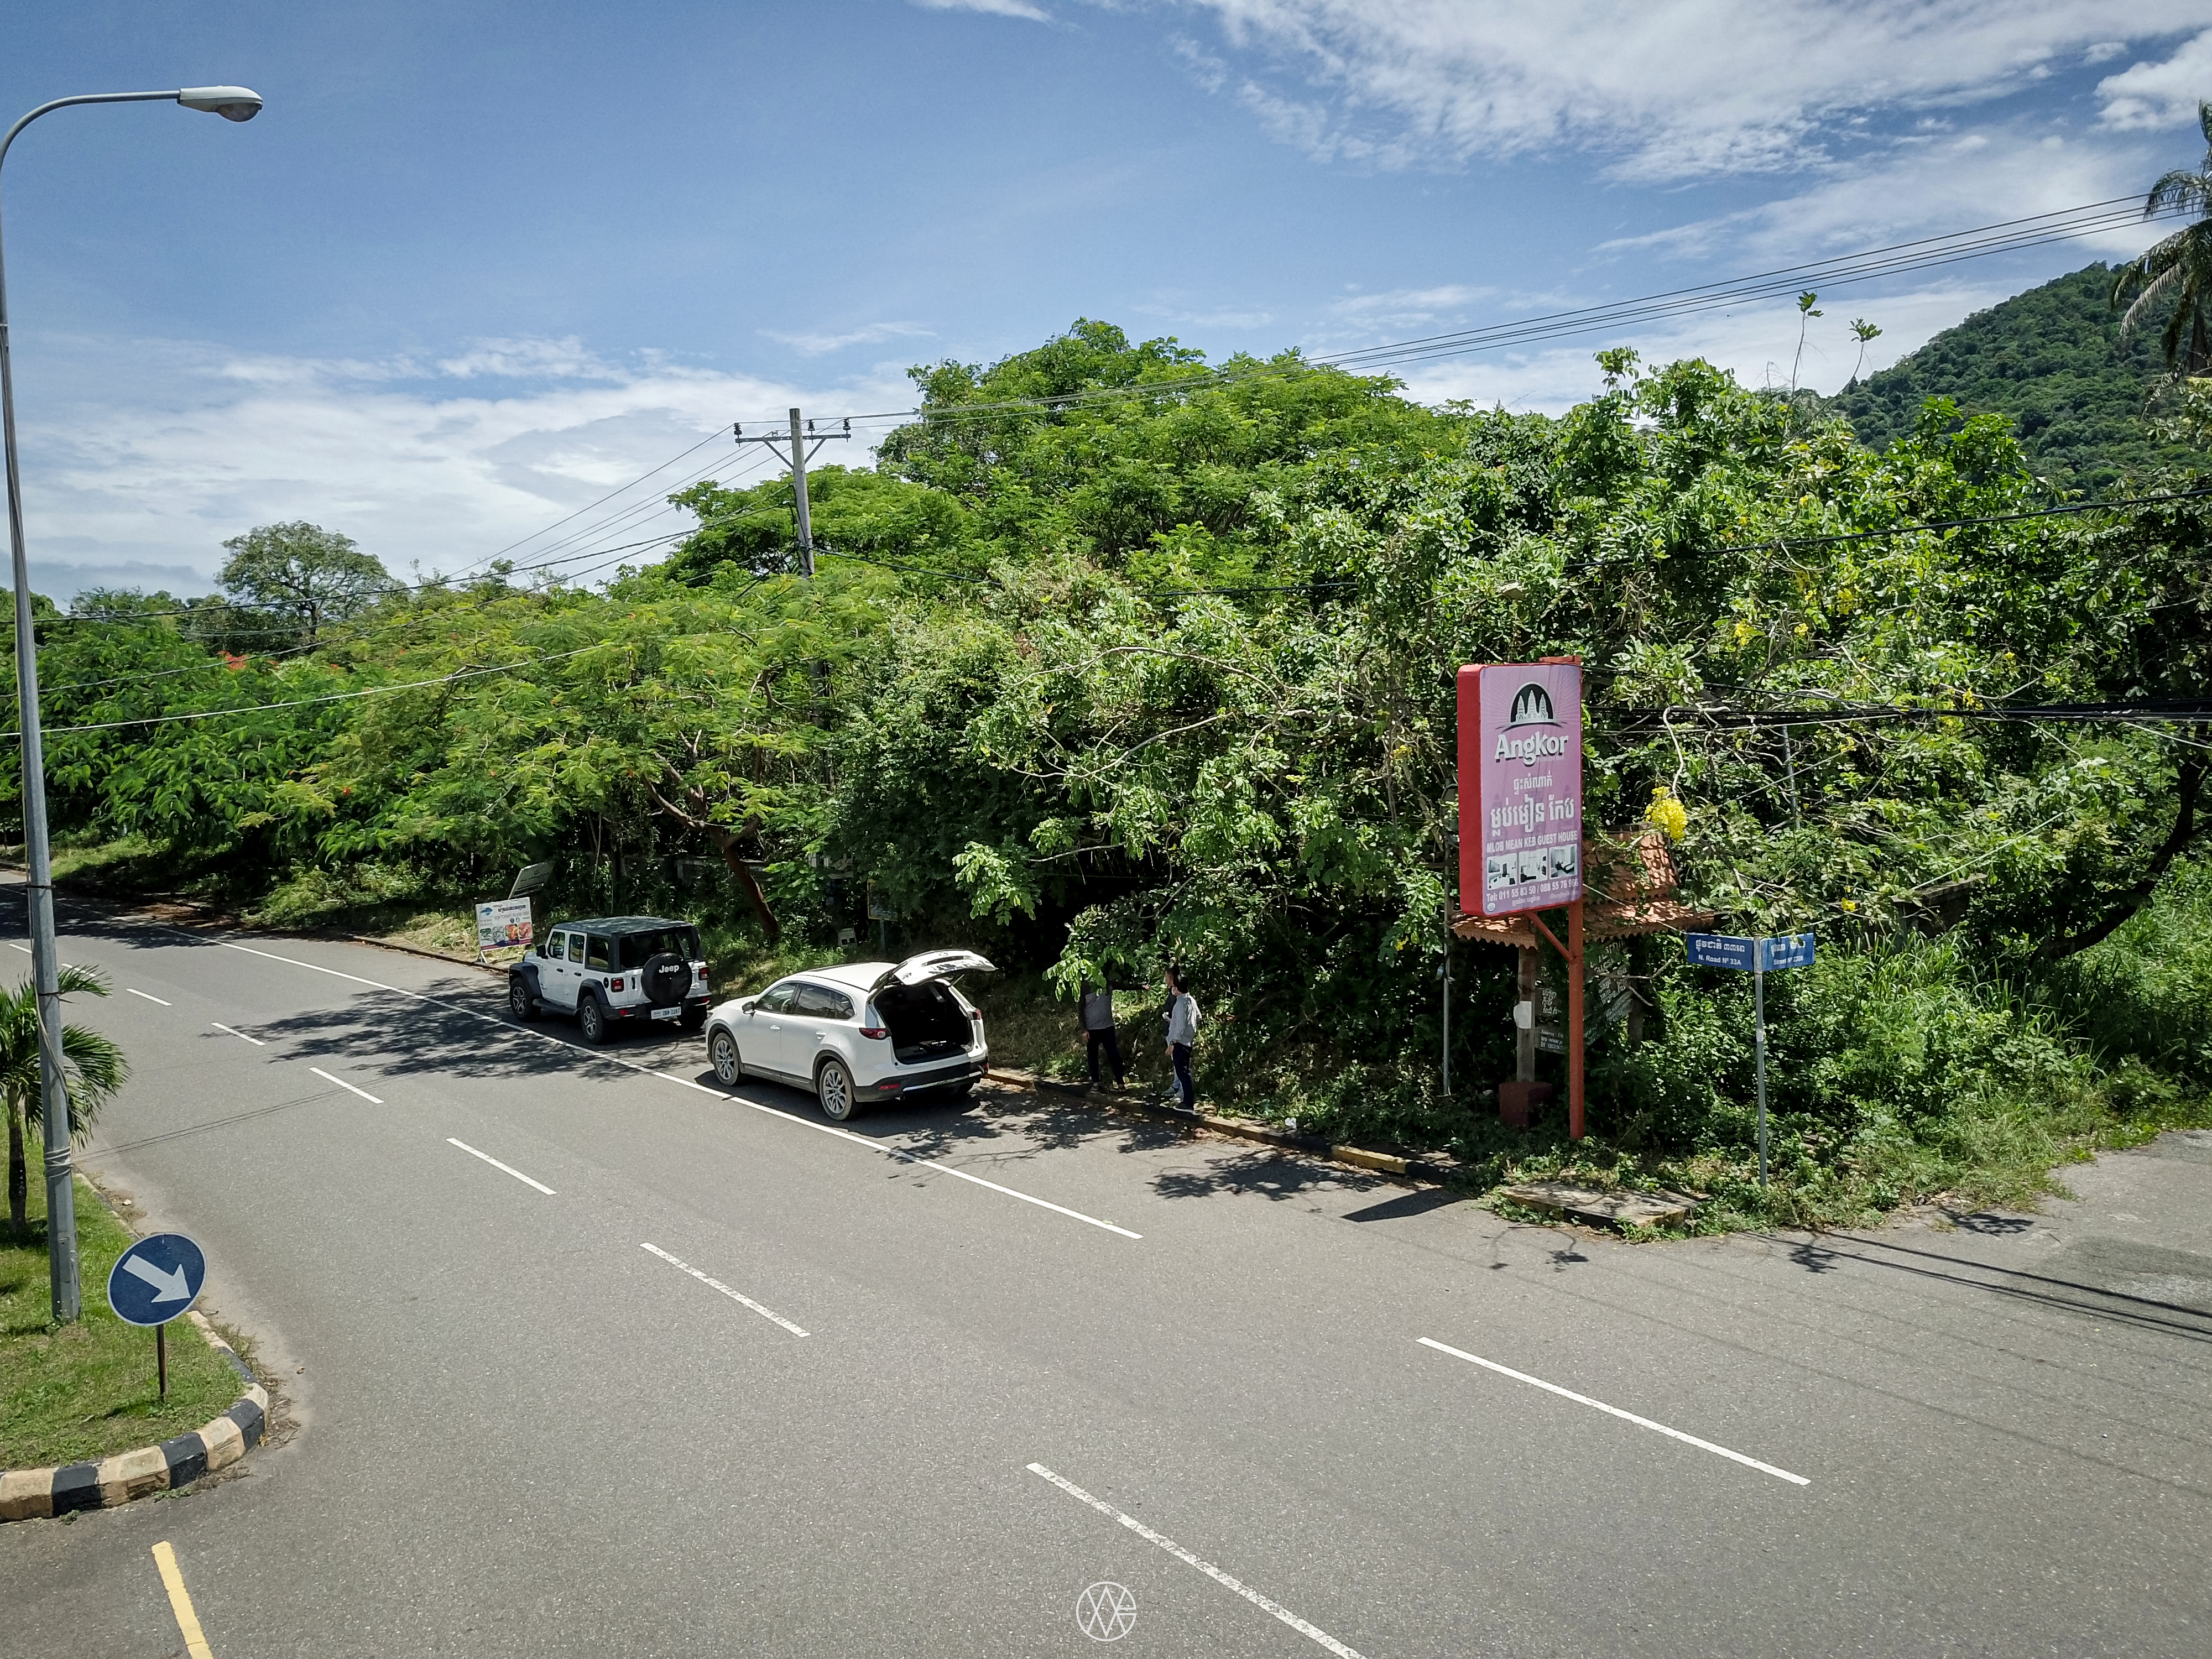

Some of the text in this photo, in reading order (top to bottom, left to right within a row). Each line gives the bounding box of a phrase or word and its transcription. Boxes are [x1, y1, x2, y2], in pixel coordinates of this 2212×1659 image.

[1494, 731, 1569, 766] Angkor
[1486, 831, 1578, 853] MLOB MEAN KEB GUEST HOUSE
[1486, 893, 1498, 902] Tel:
[1499, 889, 1510, 900] 011
[1511, 888, 1519, 898] 55
[1520, 886, 1527, 896] 83
[1528, 885, 1536, 895] 50
[1552, 881, 1559, 891] 55
[1560, 879, 1567, 889] 76
[659, 964, 680, 973] Jeep
[1705, 955, 1721, 963] Road
